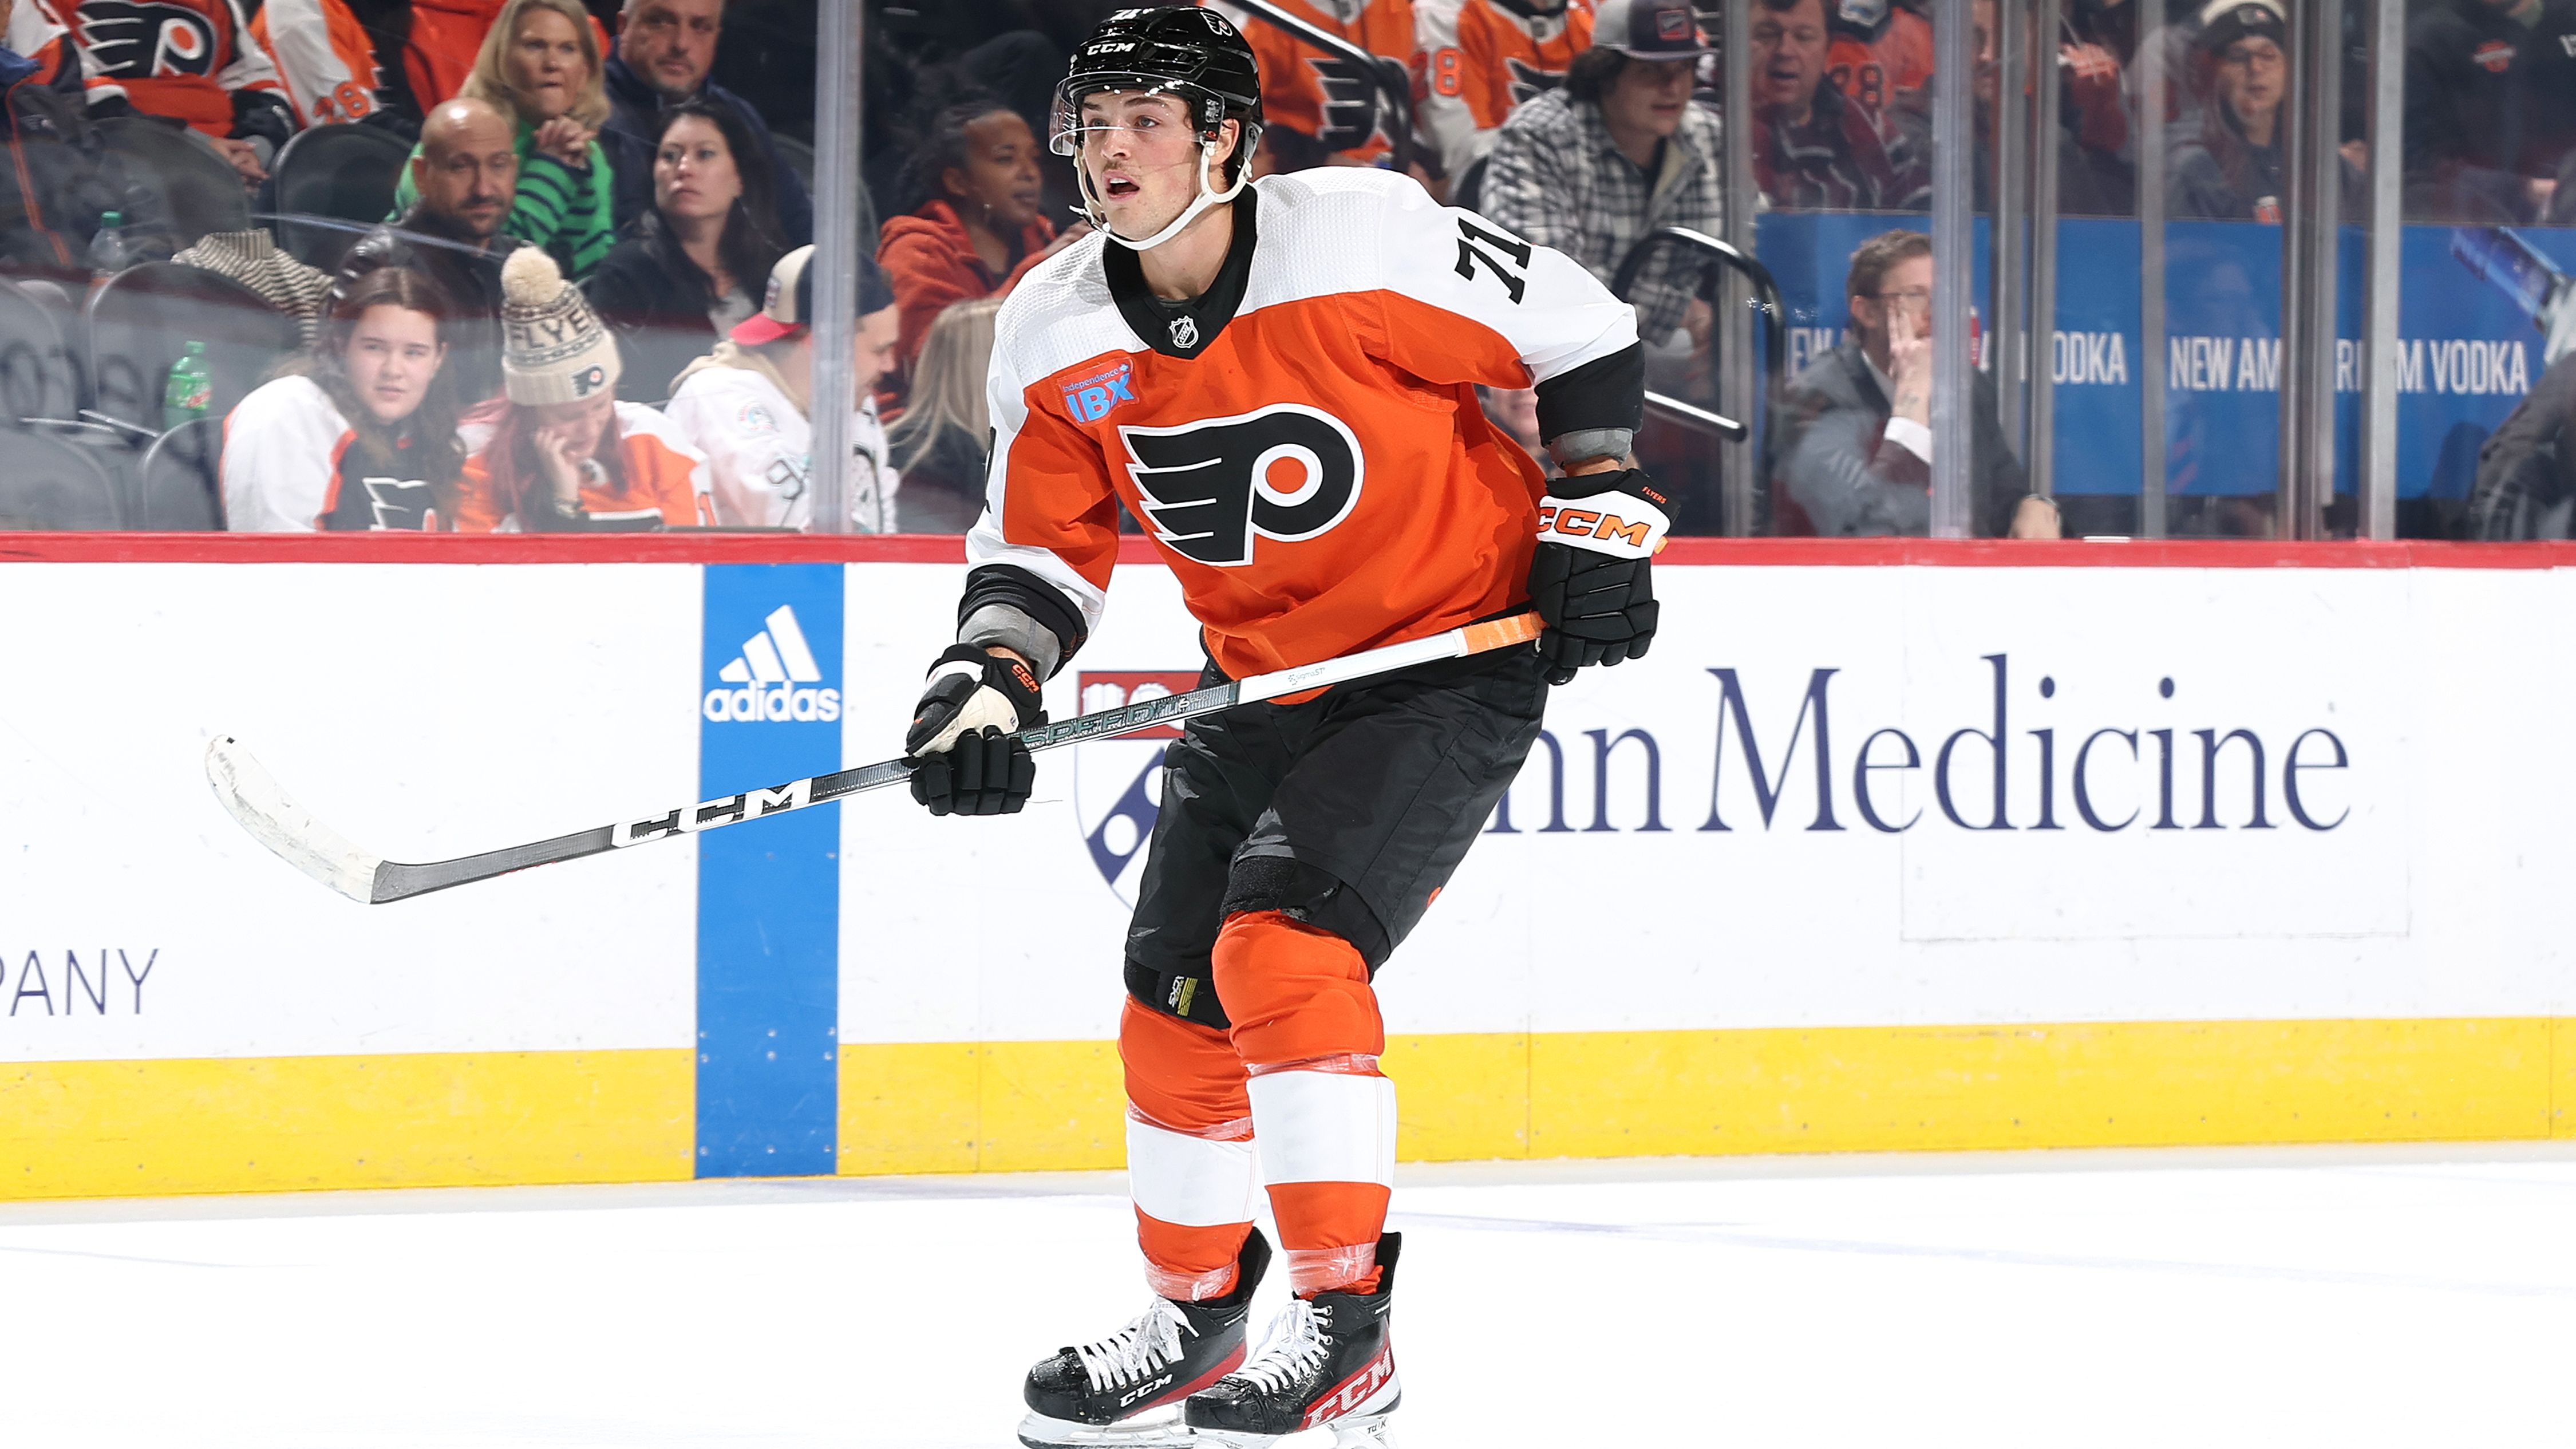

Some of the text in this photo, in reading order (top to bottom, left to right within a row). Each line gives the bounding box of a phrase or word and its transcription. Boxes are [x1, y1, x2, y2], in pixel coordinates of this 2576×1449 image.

[1087, 42, 1136, 56] CCM
[1454, 216, 1532, 305] 71
[2052, 330, 2127, 385] ODKA
[2170, 335, 2233, 390] NEW
[2429, 339, 2530, 395] VODKA
[1066, 373, 1135, 423] IBX
[1642, 487, 1667, 504] FLYERS
[703, 679, 841, 722] adidas
[1013, 664, 1040, 692] CCM
[1483, 653, 2350, 834] nn Medicine
[611, 777, 812, 848] CCM
[0, 948, 159, 1016] ANY
[1119, 1374, 1172, 1408] CCM
[1307, 1348, 1392, 1429] CCM
